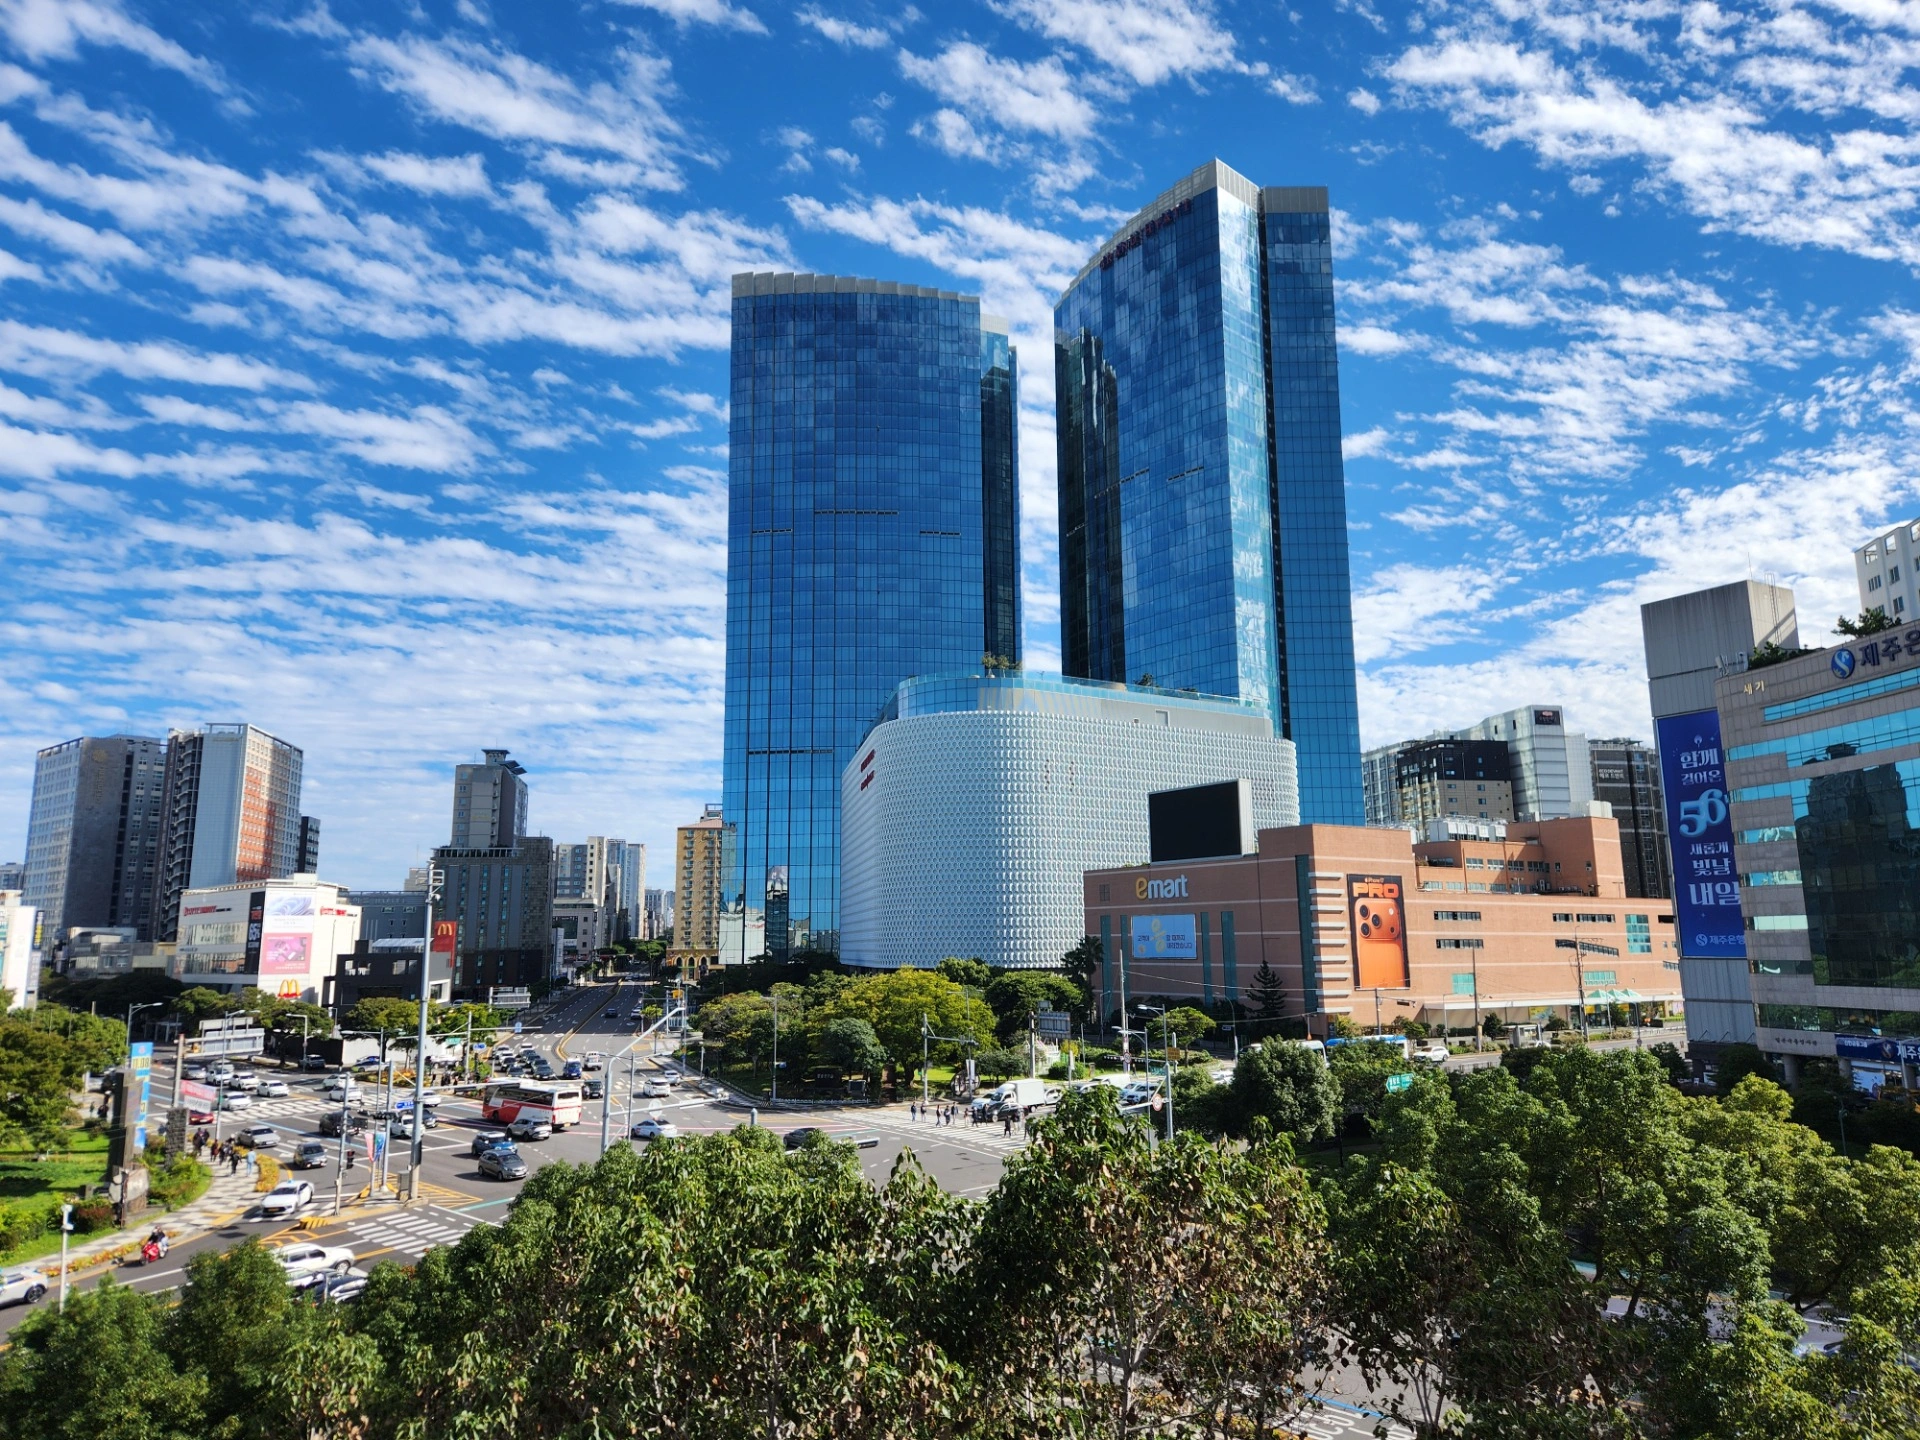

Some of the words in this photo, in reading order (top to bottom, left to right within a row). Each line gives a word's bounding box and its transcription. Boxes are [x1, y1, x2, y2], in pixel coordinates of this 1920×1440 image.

[1680, 748, 1719, 769] 함께
[1681, 770, 1721, 785] 걸어온
[1690, 841, 1730, 855] 새롭게
[1692, 858, 1731, 876] 빛날
[1136, 874, 1188, 899] emart
[1352, 882, 1399, 898] PRO
[1688, 881, 1741, 905] 내일
[1709, 935, 1745, 945] 제주은행
